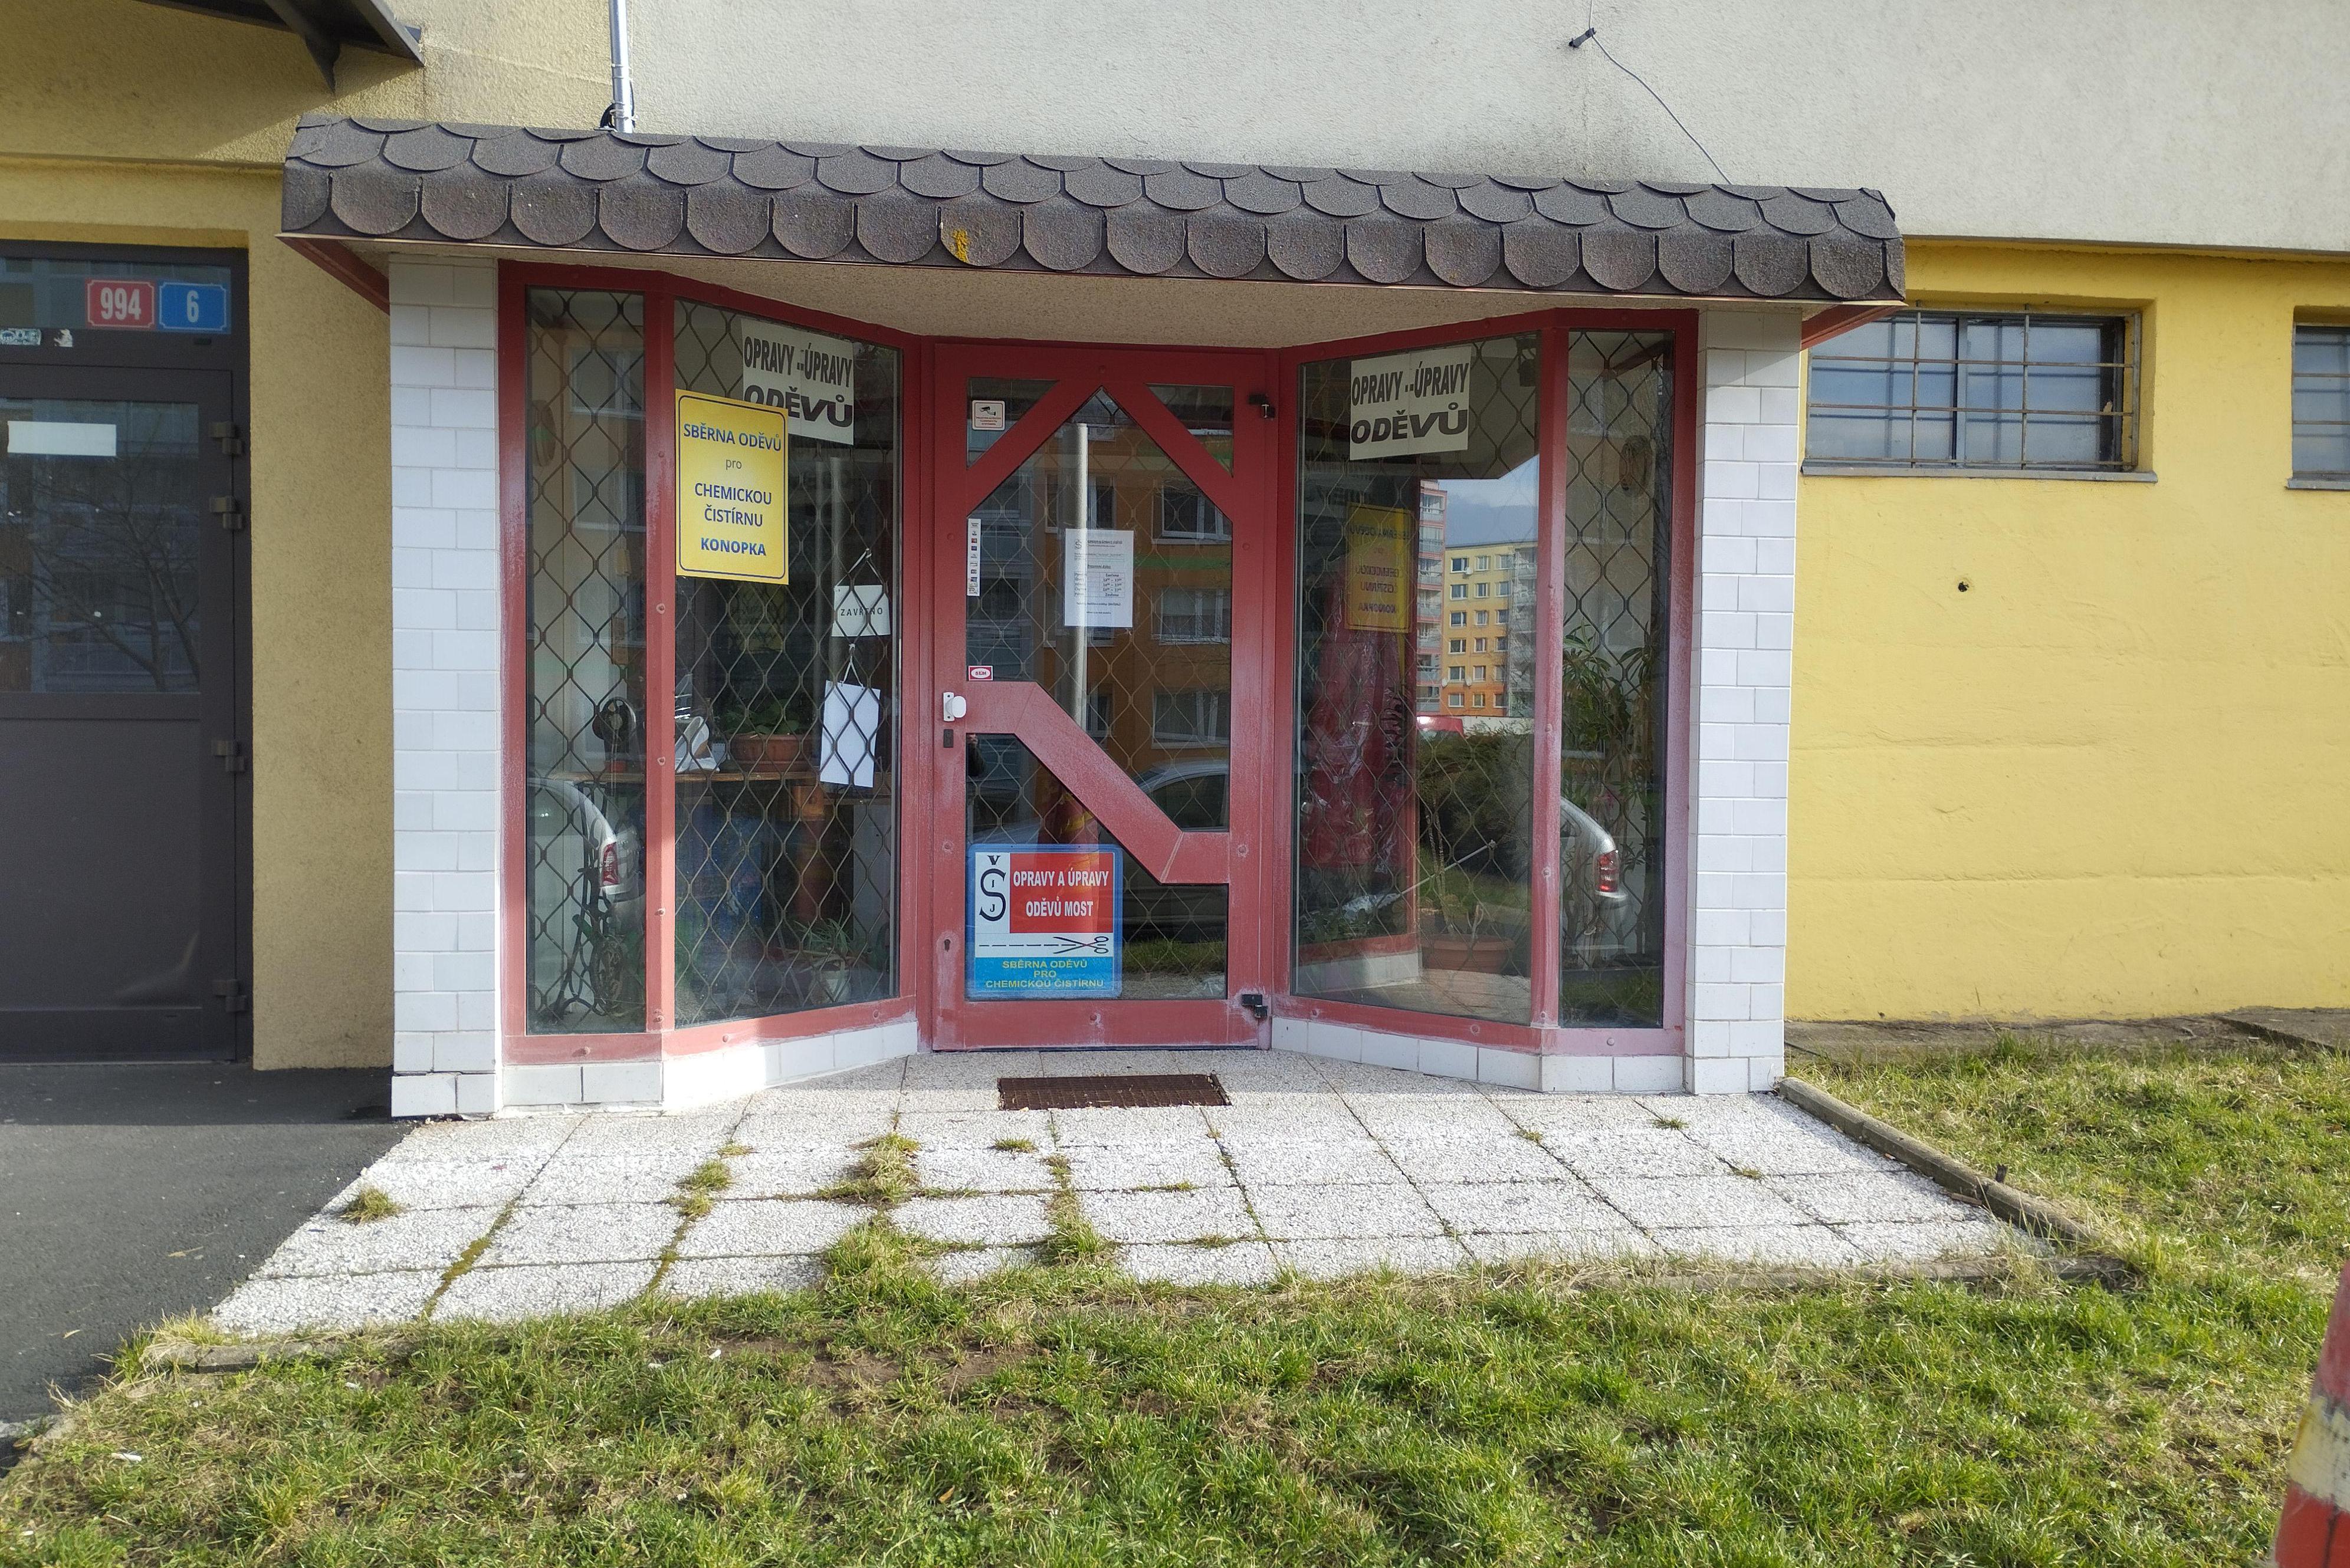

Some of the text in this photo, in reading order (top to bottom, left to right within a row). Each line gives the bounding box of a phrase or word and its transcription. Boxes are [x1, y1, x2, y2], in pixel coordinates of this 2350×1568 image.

[100, 287, 141, 320] 994
[186, 290, 199, 323] 6
[744, 336, 795, 376] OPRAVY
[805, 343, 852, 387] ÚPRAVY
[1352, 361, 1469, 406] OPRAVY ÚPRAVY
[744, 384, 852, 428] ODĚVŮ
[1351, 402, 1468, 443] ODĚVŮ
[683, 423, 782, 452] SBĚRNA ODĚVŮ
[726, 458, 742, 471] pro
[695, 482, 772, 505] CHEMICKOU
[704, 504, 763, 527] ČISTÍRNU
[701, 537, 767, 557] KONOPKA
[1013, 867, 1109, 886] OPRAVY A ÚPRAVY
[1026, 896, 1094, 916] ODĚVŮ MOST
[1002, 959, 1088, 968] SBĚRNA ODĚVŮ
[1054, 978, 1104, 988] ČISTÍRNU
